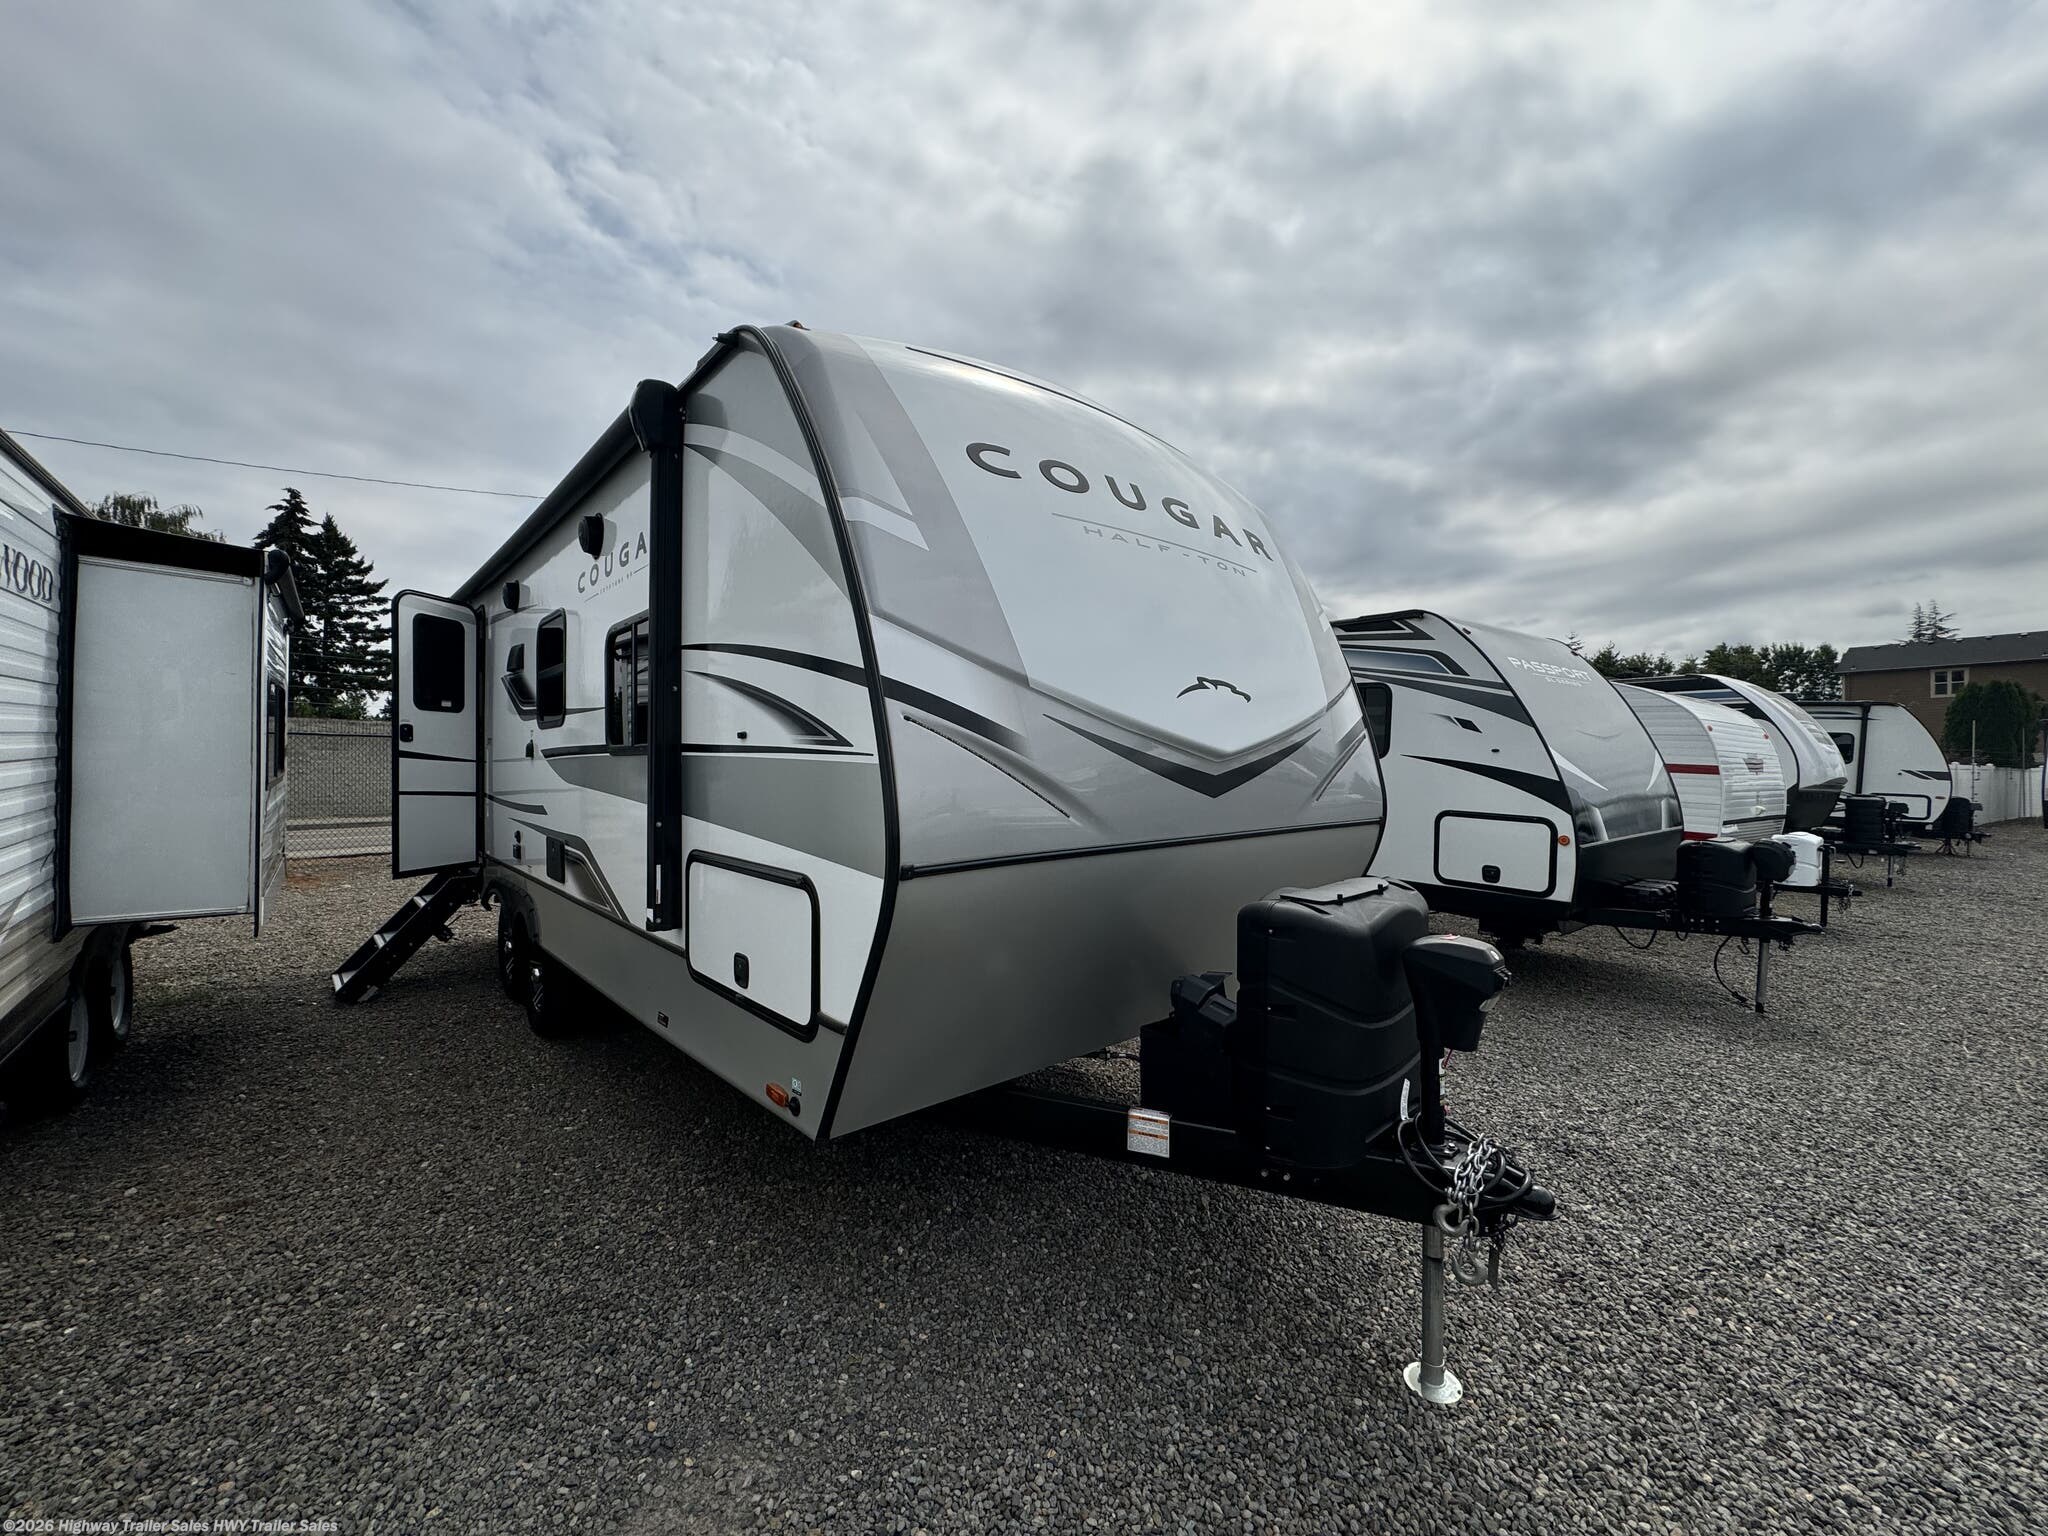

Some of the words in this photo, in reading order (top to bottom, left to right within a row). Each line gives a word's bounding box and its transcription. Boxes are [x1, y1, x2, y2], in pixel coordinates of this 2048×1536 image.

[965, 442, 1274, 562] COUGAR
[577, 531, 648, 594] COUGA
[1082, 525, 1246, 577] HALF-TON
[1507, 656, 1592, 681] PASSPORT
